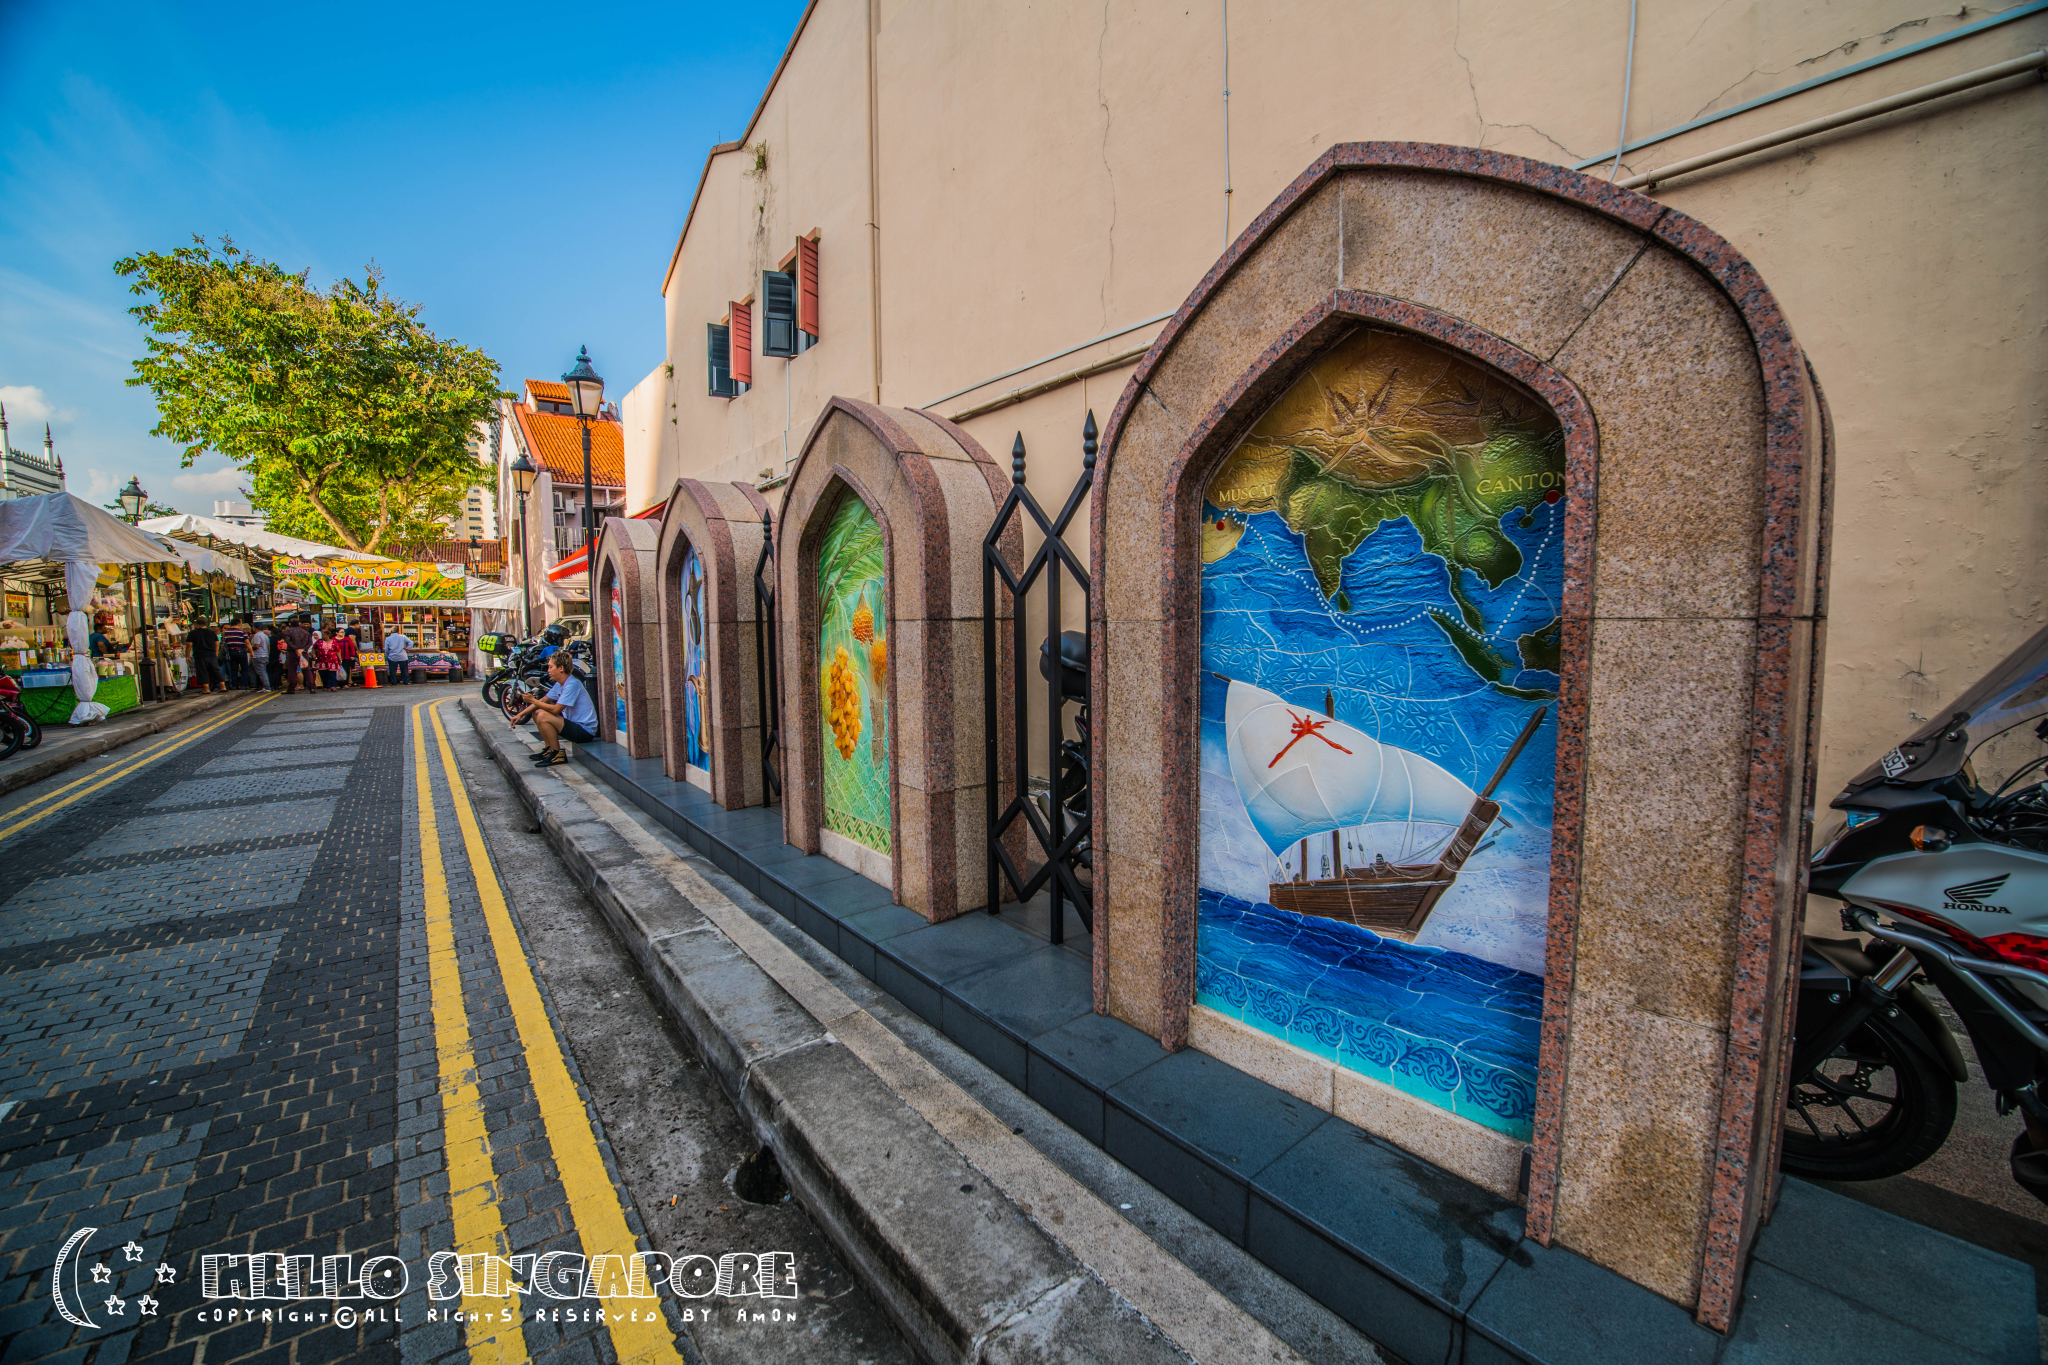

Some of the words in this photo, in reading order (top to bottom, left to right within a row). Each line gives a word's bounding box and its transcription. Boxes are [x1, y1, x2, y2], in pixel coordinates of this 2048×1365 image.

[1219, 483, 1277, 502] MUSCAT
[278, 566, 315, 574] welcome
[317, 566, 326, 574] to
[331, 566, 415, 576] RAMADAN
[330, 574, 369, 588] Sultan
[374, 575, 416, 588] Bazaar
[357, 588, 393, 596] 2018
[478, 634, 499, 652] 09
[1942, 902, 2012, 914] HONDA
